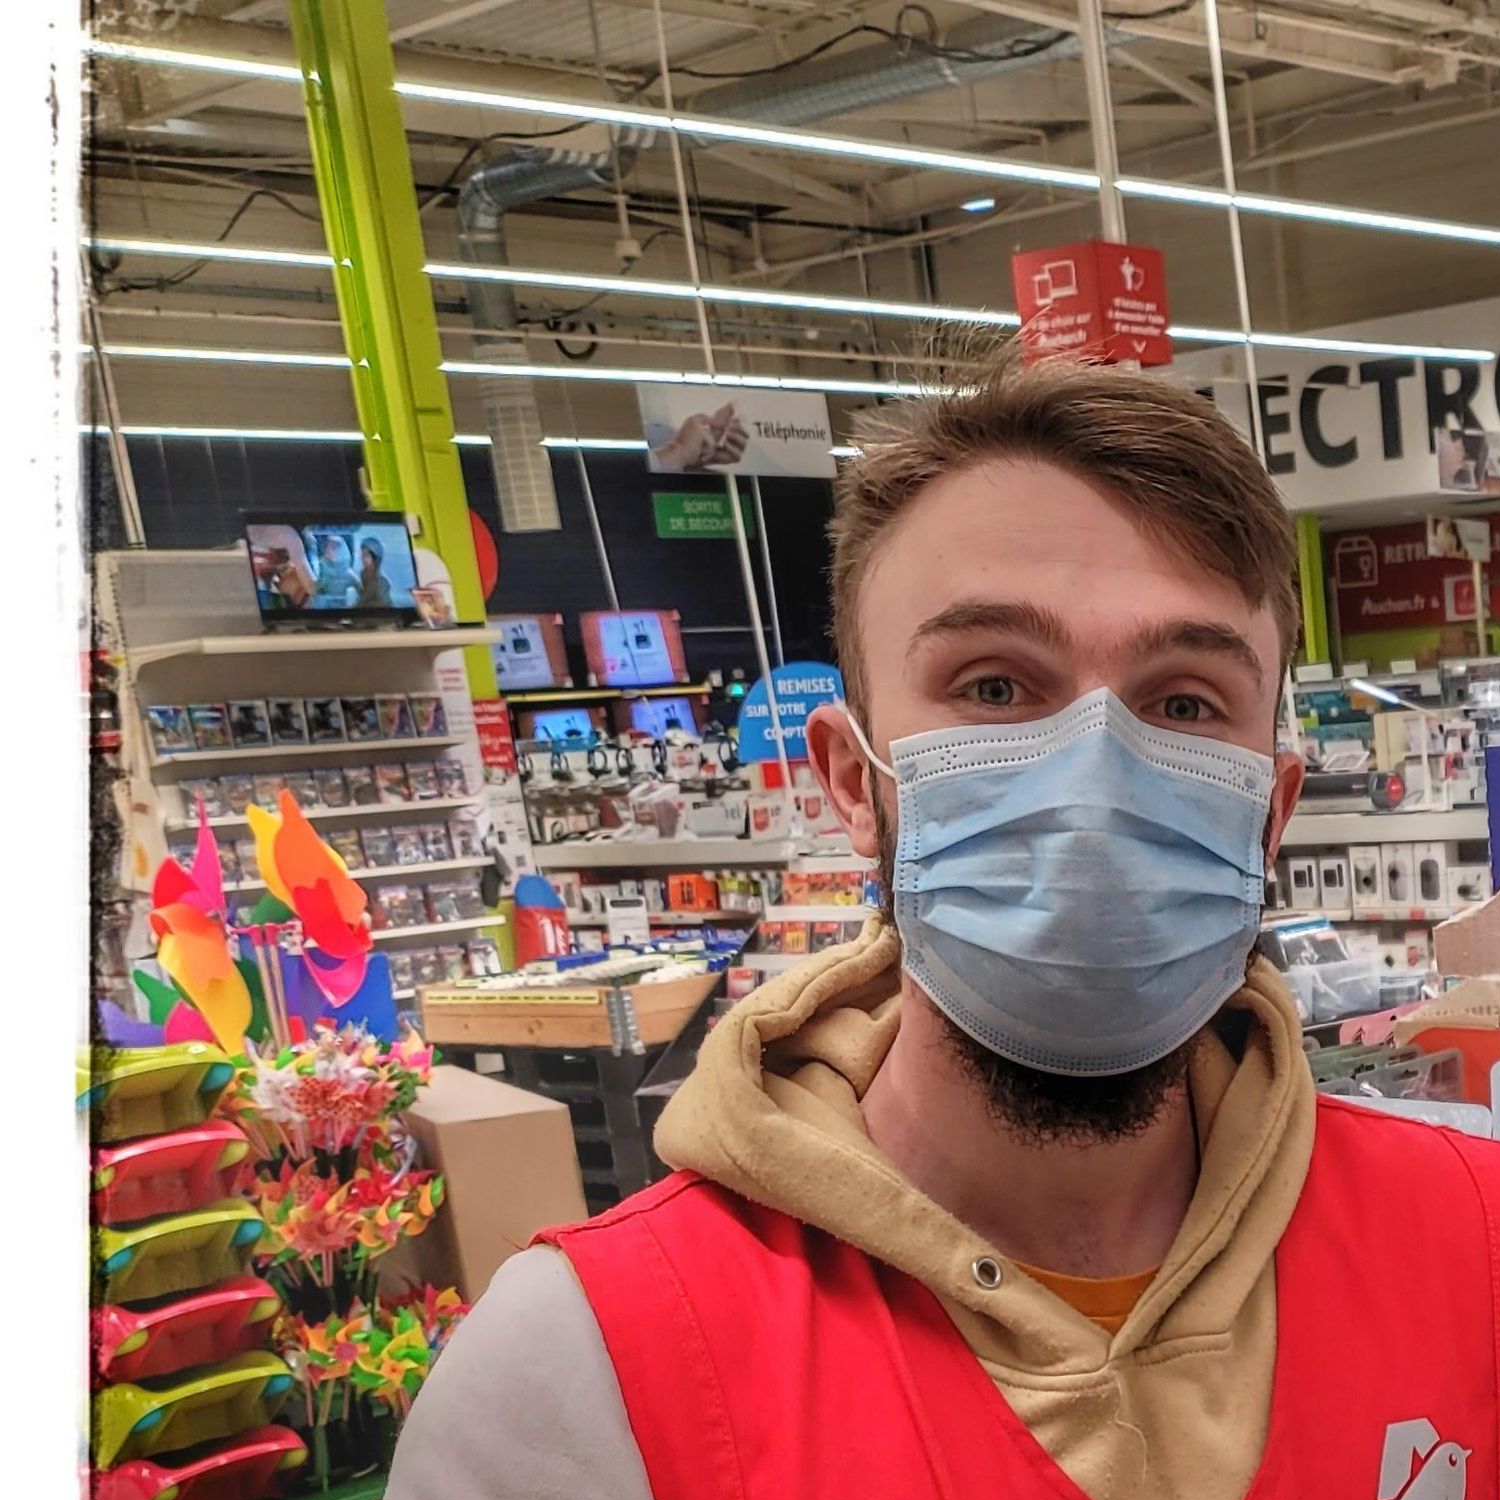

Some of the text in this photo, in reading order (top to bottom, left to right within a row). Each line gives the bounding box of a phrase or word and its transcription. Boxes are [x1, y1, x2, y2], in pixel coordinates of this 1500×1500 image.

[753, 421, 826, 443] Téléphonie
[777, 678, 836, 695] REMISES
[745, 703, 807, 718] SUR OTRE
